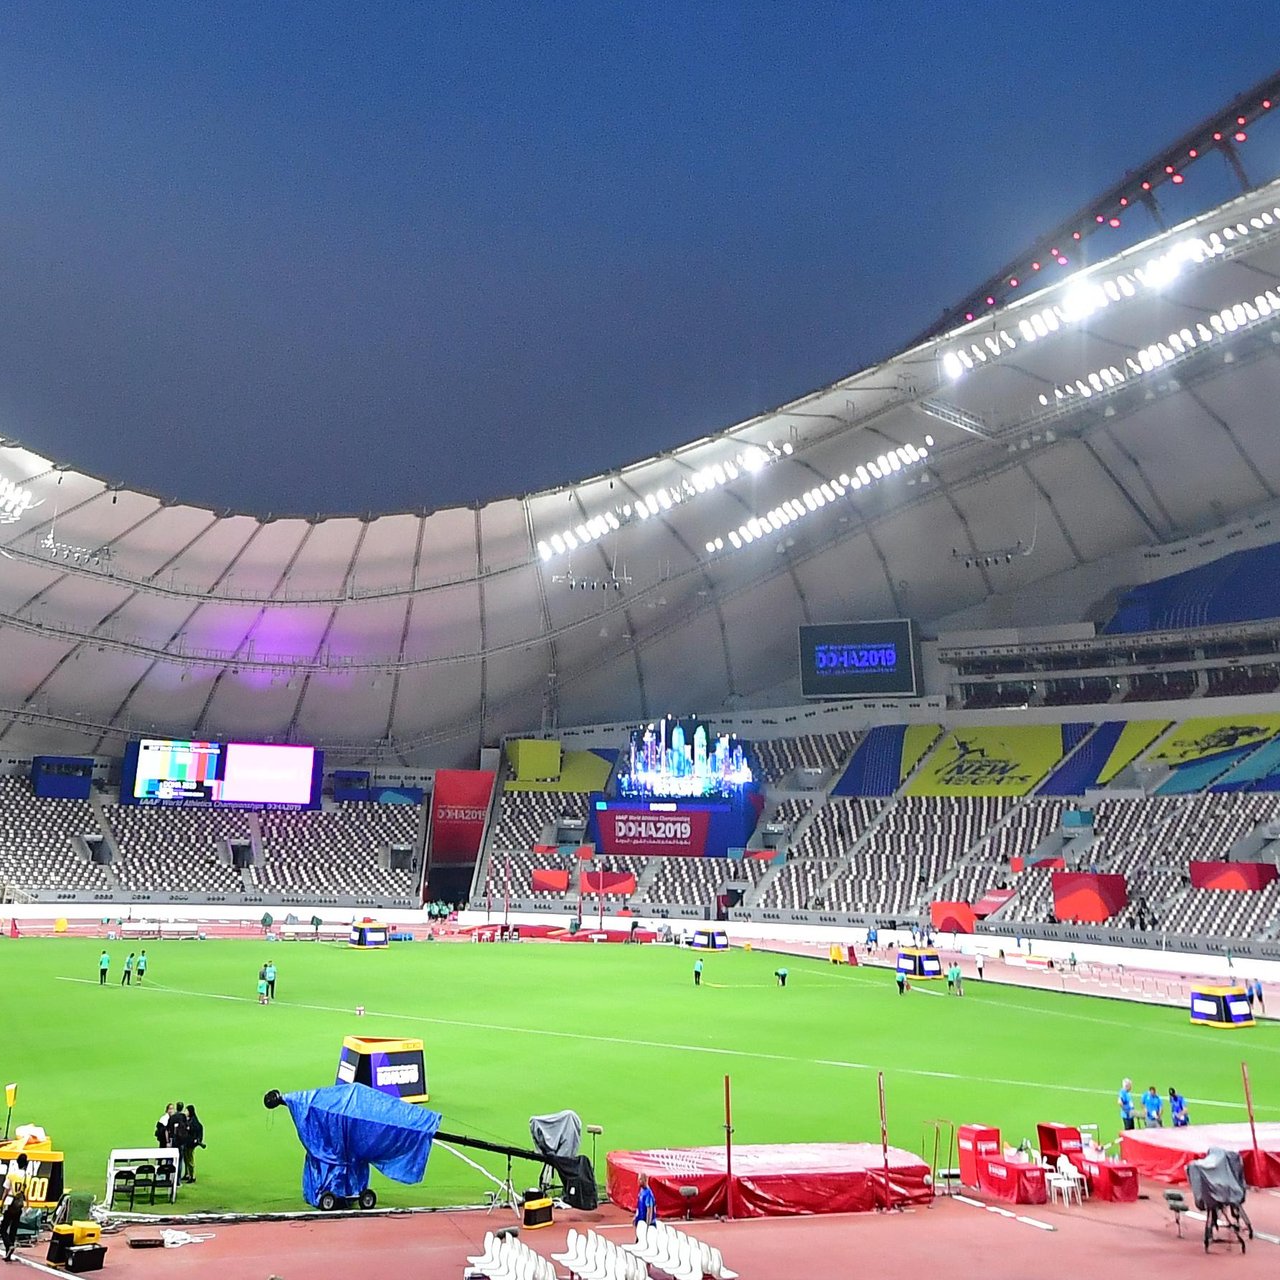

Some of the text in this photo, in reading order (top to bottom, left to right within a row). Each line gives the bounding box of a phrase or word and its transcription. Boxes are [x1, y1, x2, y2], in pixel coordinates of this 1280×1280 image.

[162, 799, 183, 807] World
[184, 800, 212, 808] Athletics
[214, 801, 264, 811] Championships
[615, 821, 691, 838] DOHA2019
